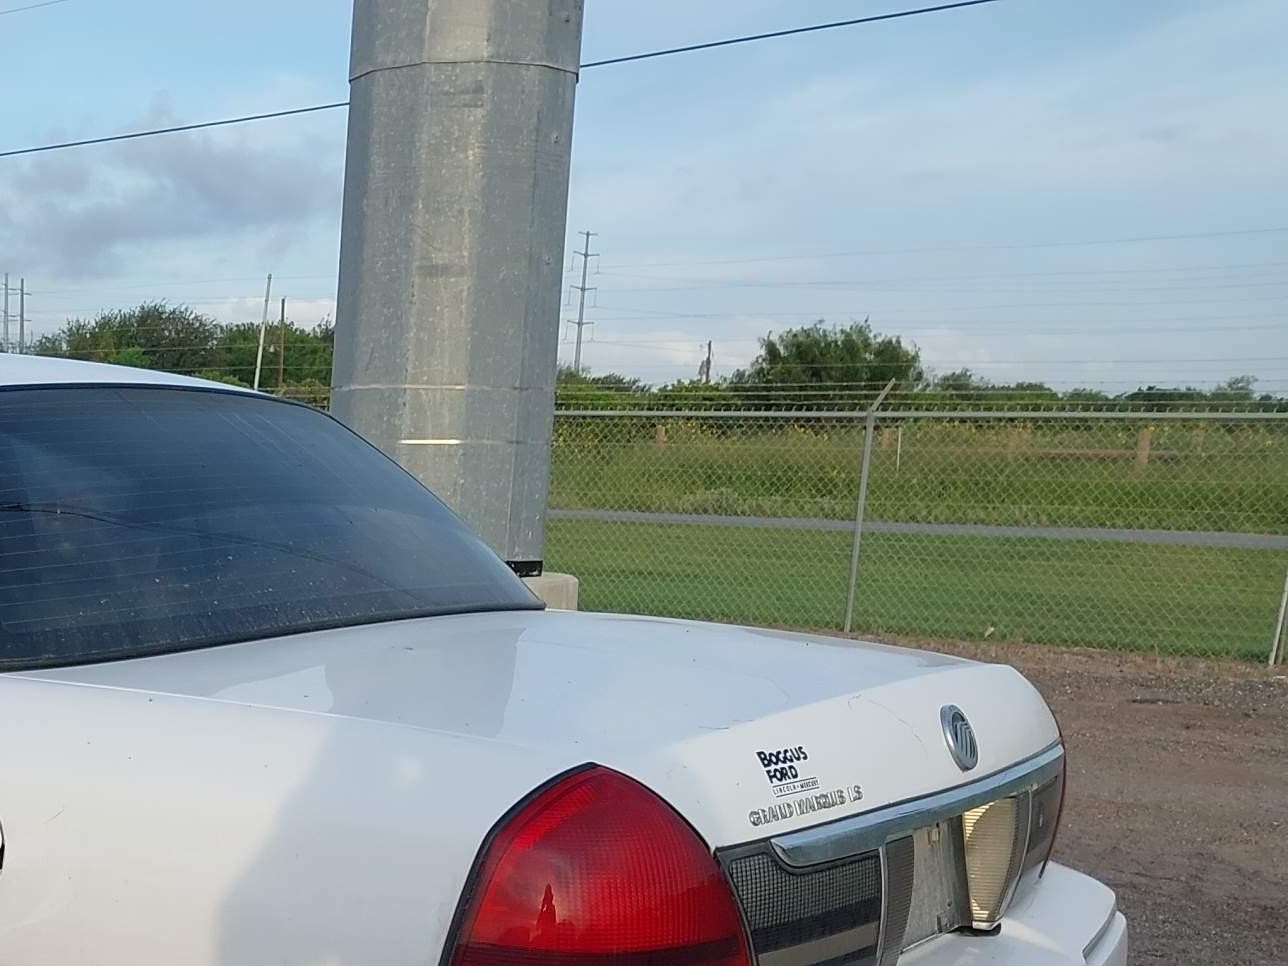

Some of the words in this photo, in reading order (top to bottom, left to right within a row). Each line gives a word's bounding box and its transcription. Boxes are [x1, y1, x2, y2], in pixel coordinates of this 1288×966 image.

[756, 746, 808, 768] BOGGUS
[765, 765, 799, 784] FORD
[749, 802, 794, 826] GRAND
[793, 789, 847, 816] MARQUIS
[847, 785, 864, 803] LS
